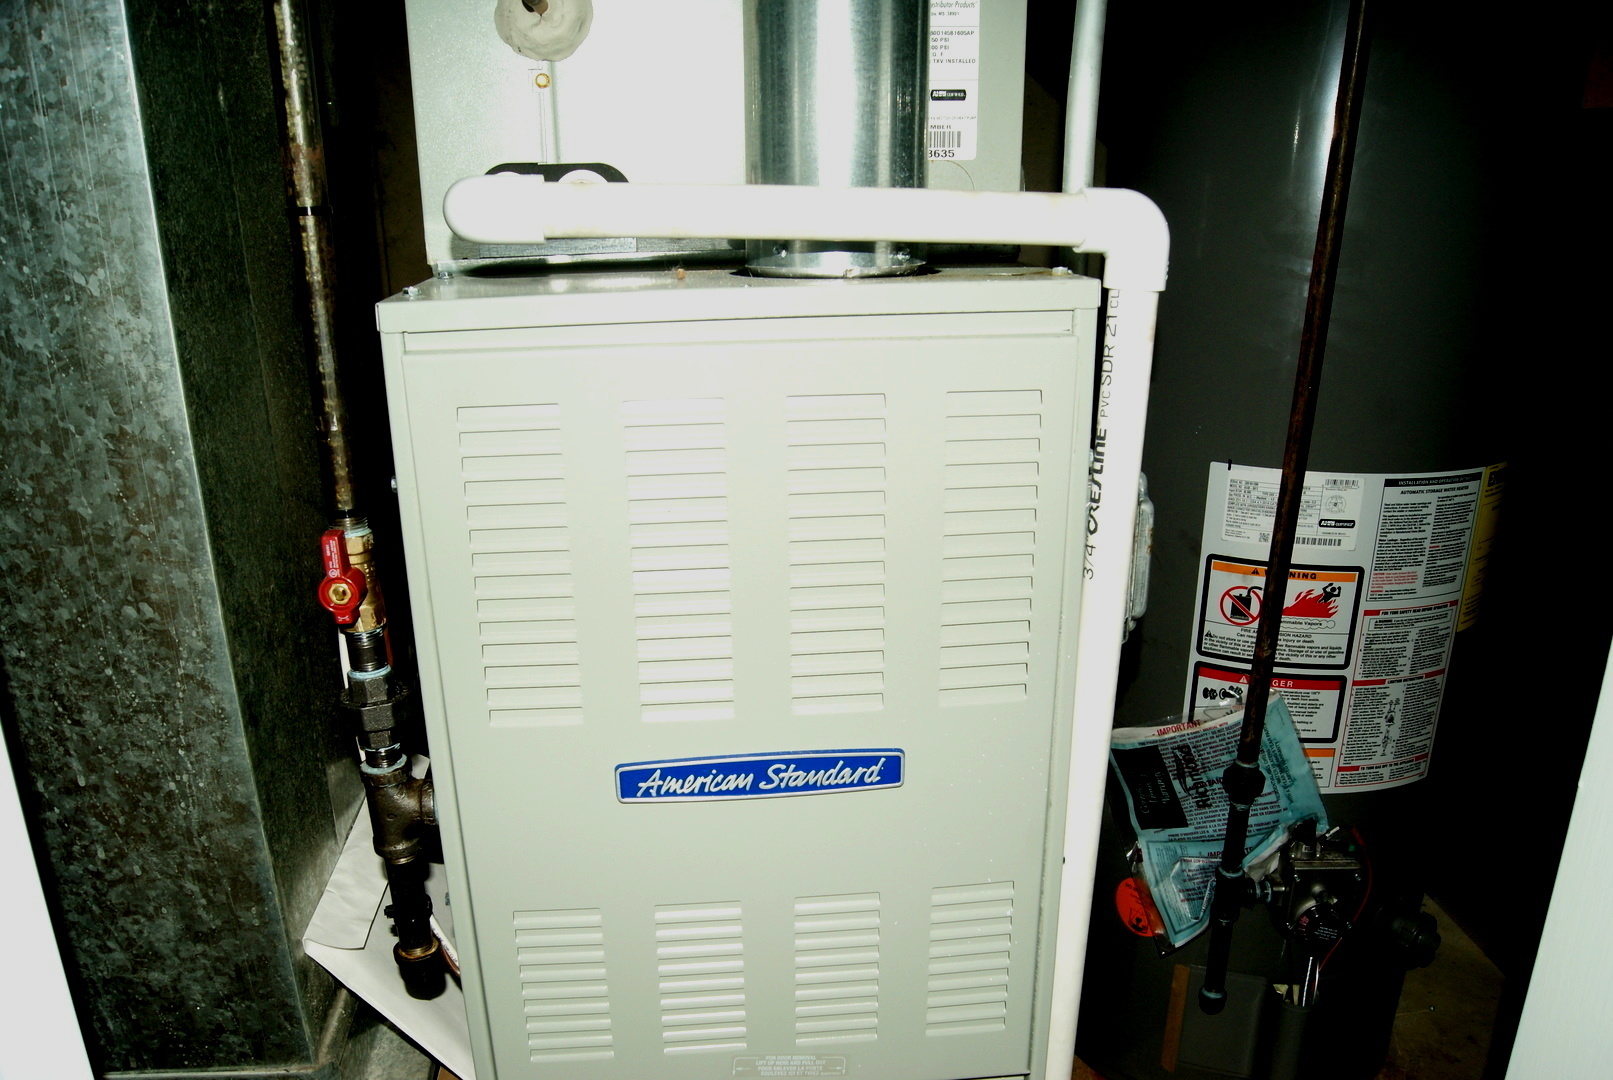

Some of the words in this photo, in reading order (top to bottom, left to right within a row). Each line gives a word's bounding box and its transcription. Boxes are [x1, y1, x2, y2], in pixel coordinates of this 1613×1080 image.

[1105, 315, 1118, 337] 21
[1101, 343, 1116, 386] SDR
[1100, 390, 1111, 418] PVC
[1157, 720, 1200, 736] IMPORTANT
[636, 769, 753, 798] American
[758, 757, 886, 790] Standard
